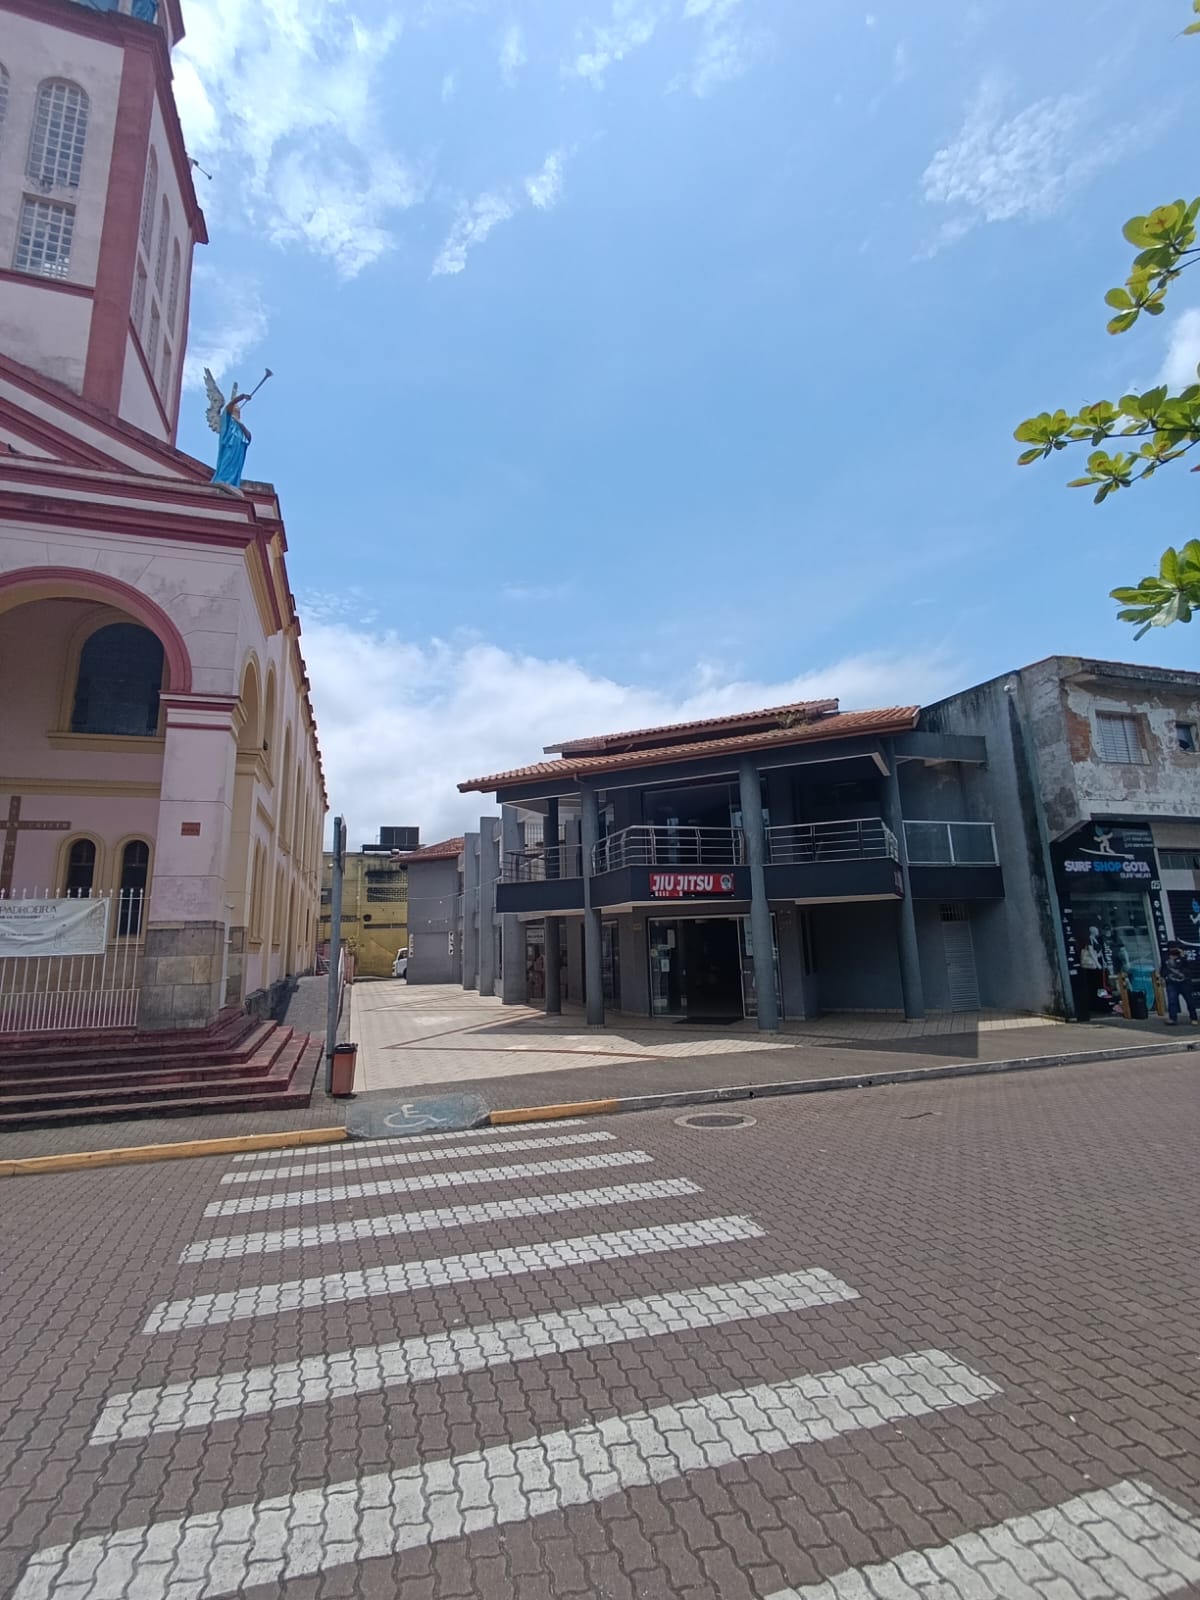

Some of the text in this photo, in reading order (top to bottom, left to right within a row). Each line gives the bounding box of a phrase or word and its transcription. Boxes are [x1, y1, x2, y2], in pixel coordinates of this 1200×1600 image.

[1064, 861, 1151, 872] SURF SHOP GOTA
[652, 874, 714, 891] JIU JITSU
[0, 905, 57, 914] PADROEIRA
